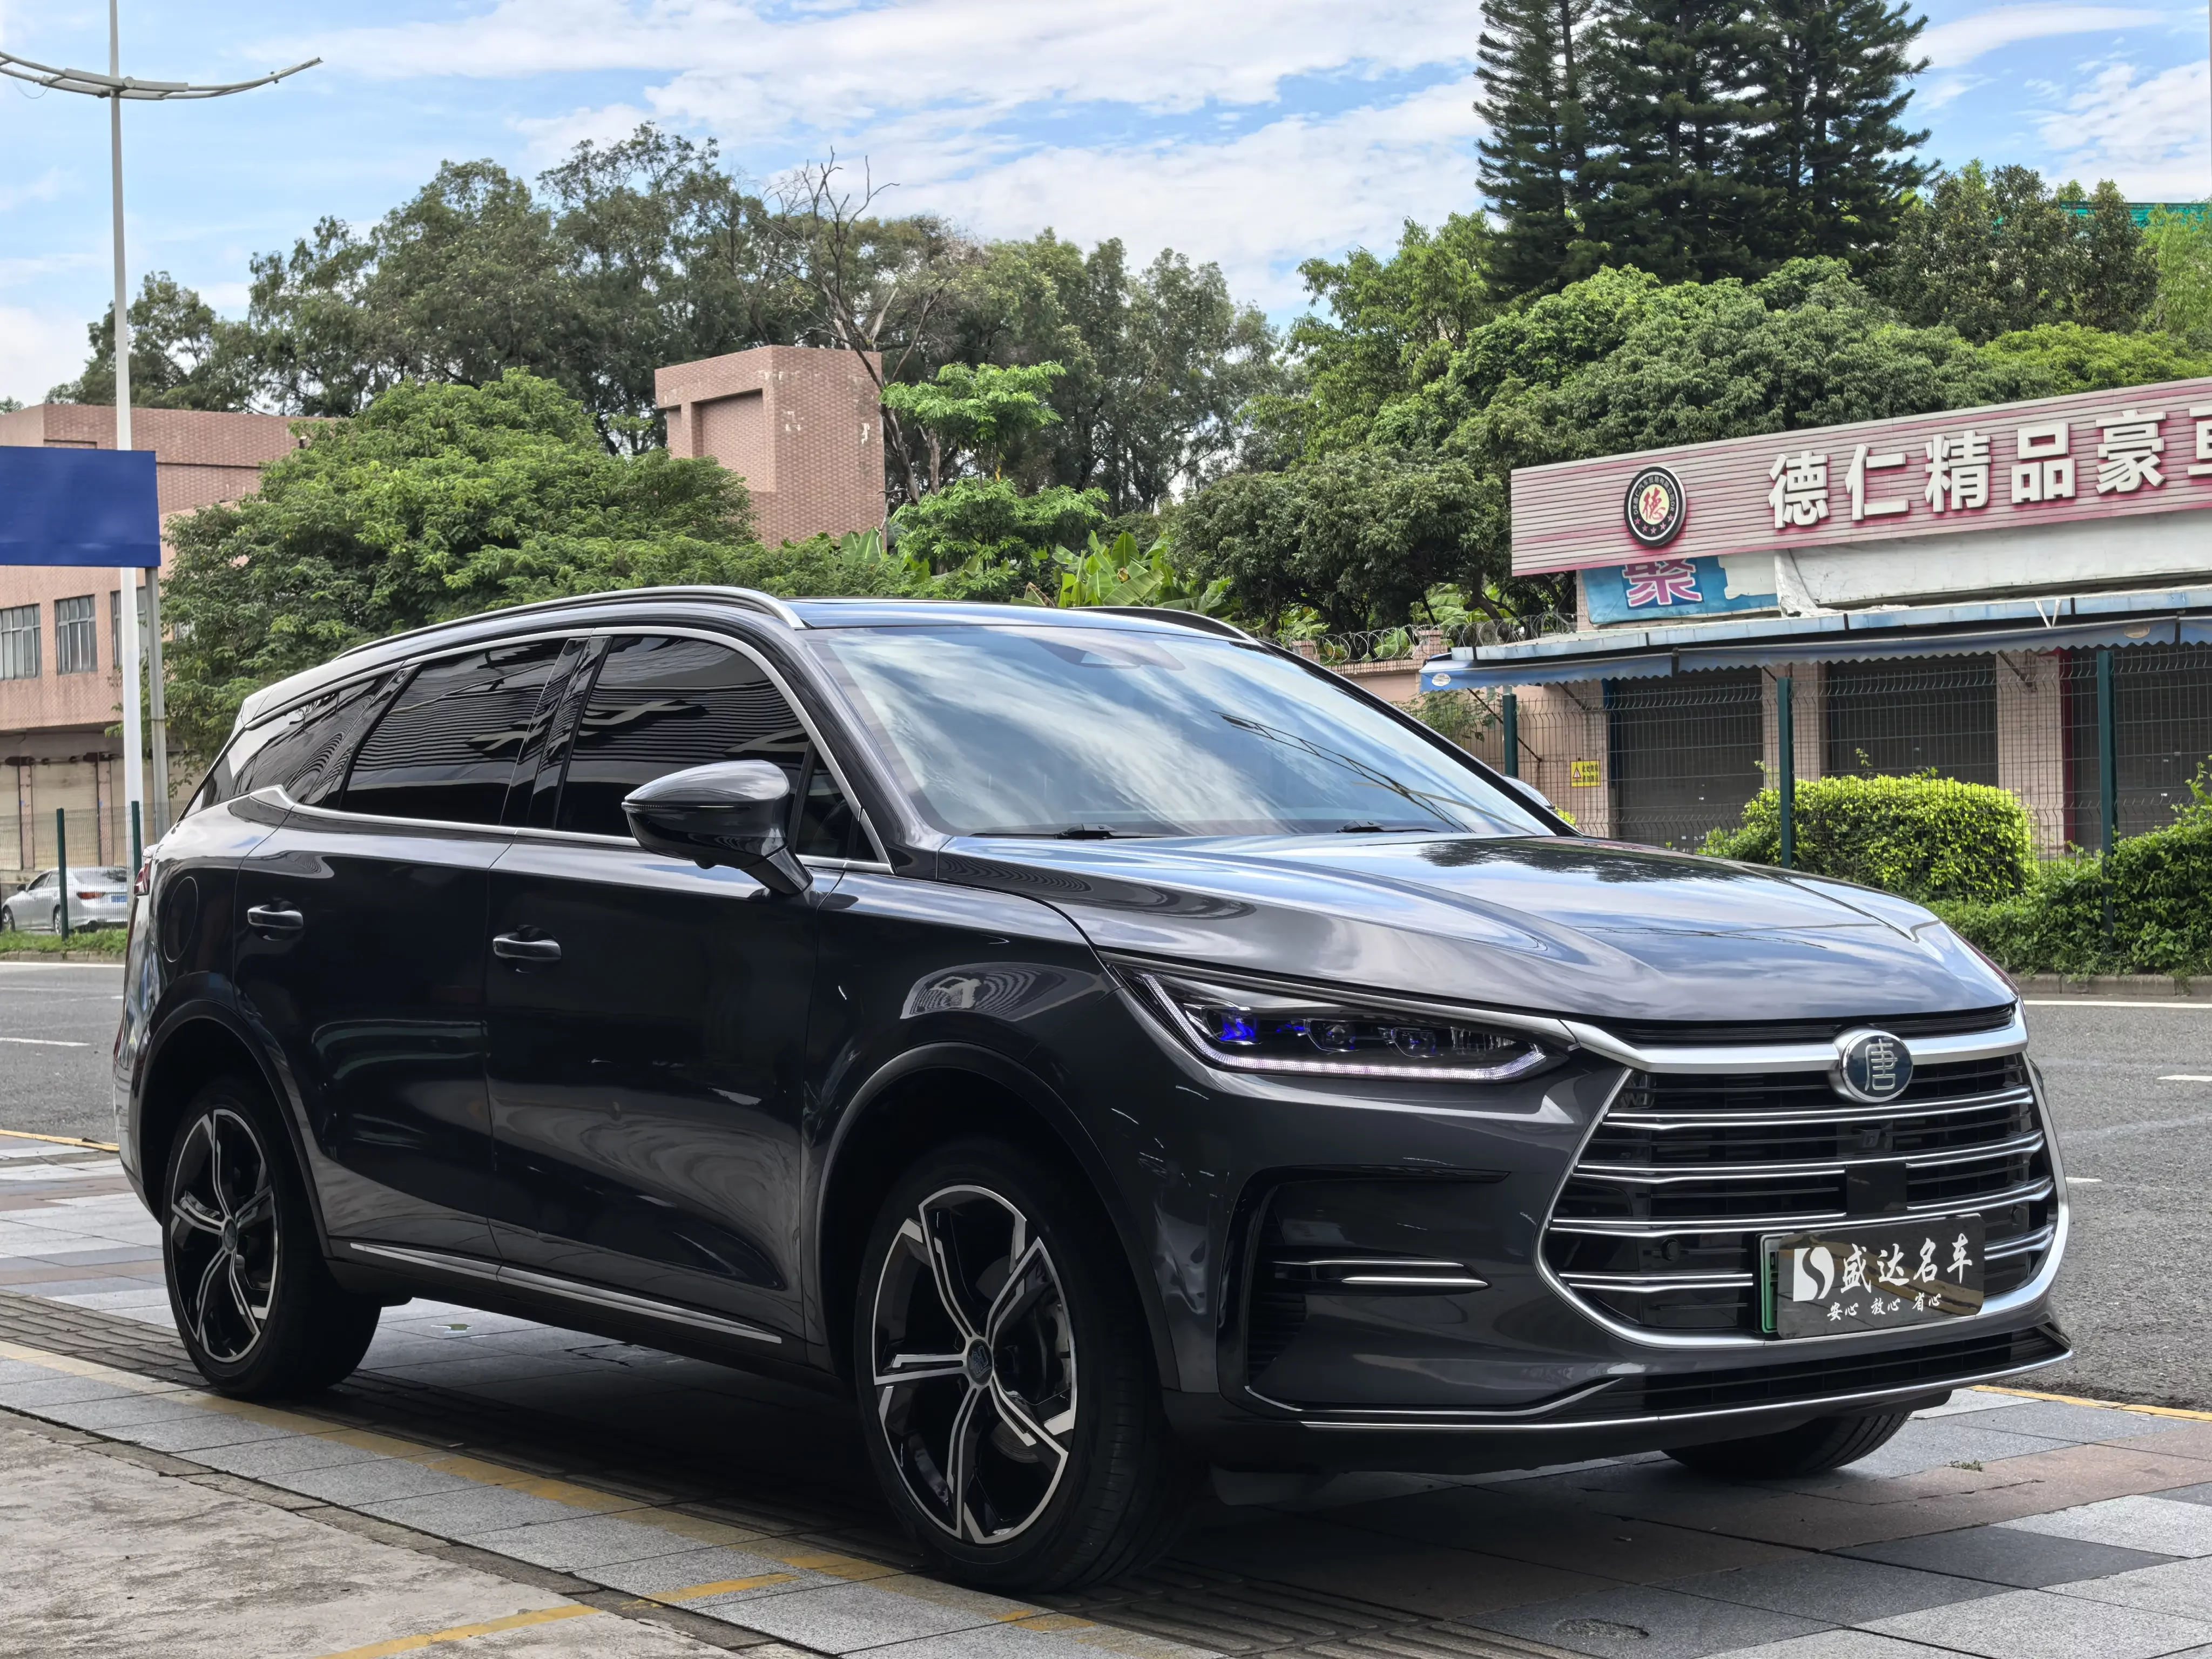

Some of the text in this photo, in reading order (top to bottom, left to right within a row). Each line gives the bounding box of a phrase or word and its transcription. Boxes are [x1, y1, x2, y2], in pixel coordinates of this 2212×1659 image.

[1840, 1233, 1972, 1293] 盛达名车
[1827, 1292, 1942, 1321] 安心 放心 省心
